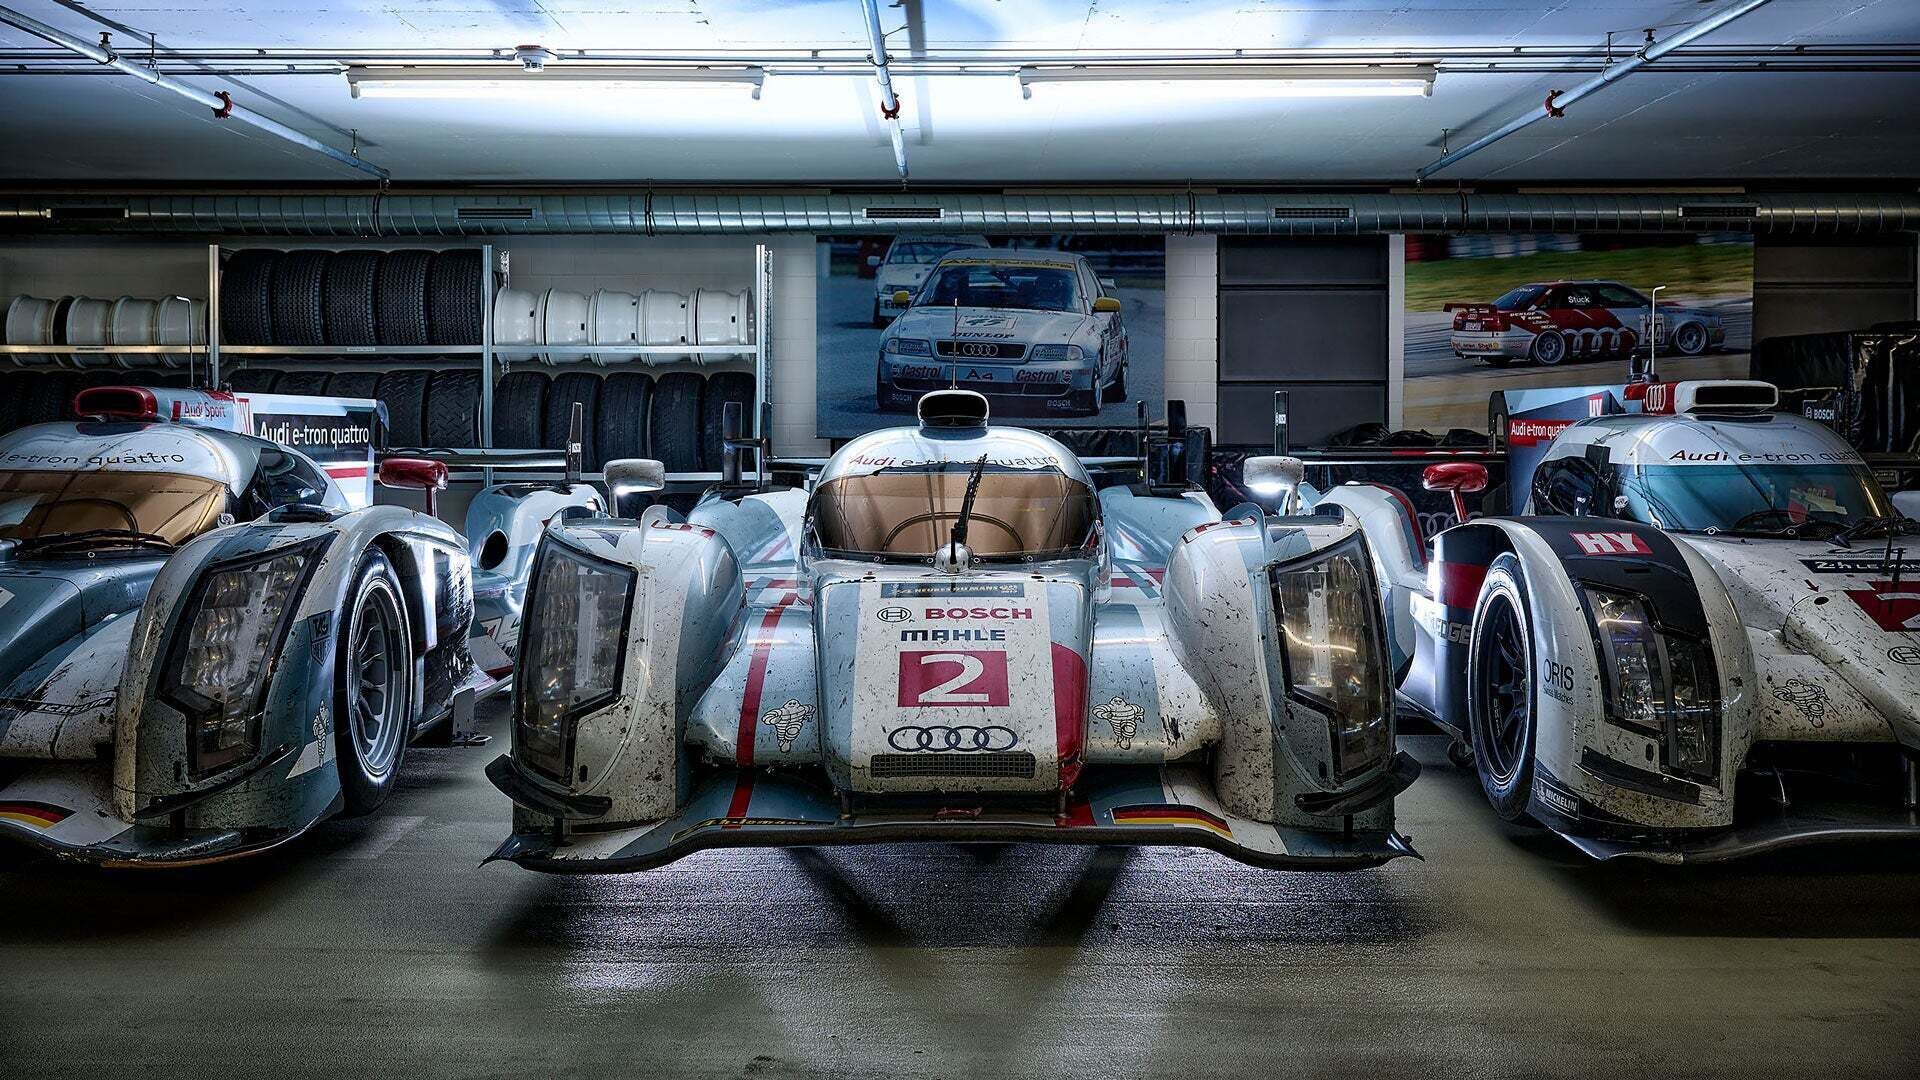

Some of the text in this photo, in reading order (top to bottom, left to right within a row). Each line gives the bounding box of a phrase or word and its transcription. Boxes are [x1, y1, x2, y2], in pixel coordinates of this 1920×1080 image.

[1567, 295, 1590, 304] Stuck
[903, 365, 941, 378] Castrol
[965, 367, 992, 381] A4
[1015, 369, 1059, 383] Castrol
[184, 401, 203, 417] Audi
[204, 402, 226, 418] Sport
[1046, 399, 1072, 408] BOSCH
[1812, 408, 1836, 420] BOSCH
[259, 421, 370, 450] Audi e-tron quattro
[1511, 422, 1526, 436] Audi
[1526, 424, 1547, 437] e-tron
[7, 453, 185, 466] e-tron quattro
[849, 454, 894, 466] Audi
[985, 454, 1059, 467] quattro
[1669, 449, 1729, 462] Audi
[1738, 451, 1813, 462] e-tron
[1573, 532, 1638, 554] HY
[925, 608, 1032, 619] BOSCH
[900, 629, 1006, 641] MAHLE
[916, 653, 990, 703] 2
[1543, 658, 1574, 691] ORIS
[1545, 788, 1577, 812] MICHELIN
